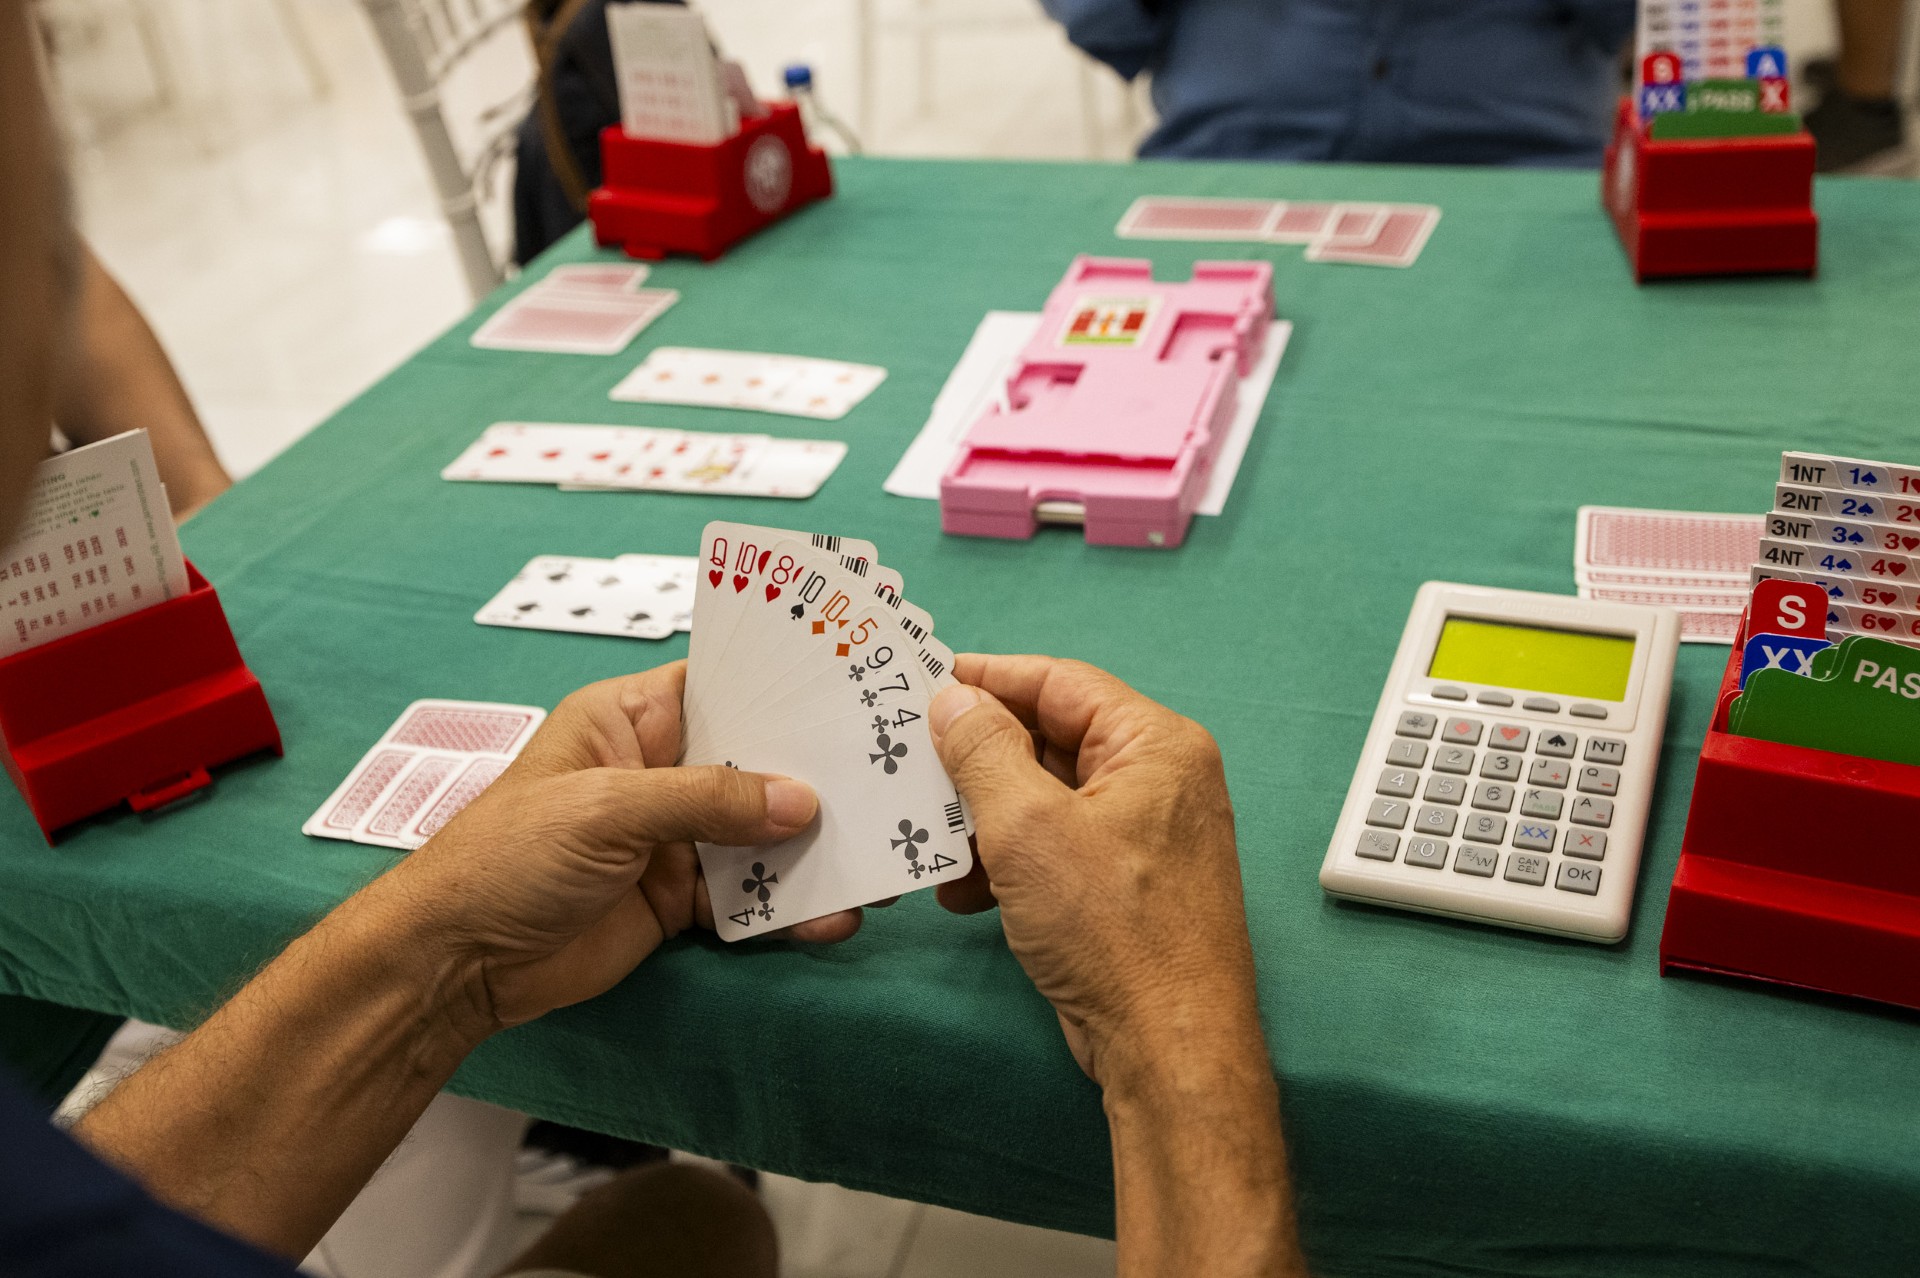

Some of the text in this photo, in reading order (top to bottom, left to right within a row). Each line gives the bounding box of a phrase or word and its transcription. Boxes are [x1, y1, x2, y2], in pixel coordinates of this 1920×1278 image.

[1790, 464, 1826, 484] 1NT
[1781, 492, 1822, 512] 2NT
[1771, 519, 1812, 539] 3NT
[1764, 547, 1804, 567] 4NT
[1776, 595, 1806, 630] S
[710, 538, 922, 729] Q 10 8 10 10 5 9 7 4
[1592, 740, 1620, 754] NT
[1402, 744, 1413, 757] 1
[1447, 750, 1463, 764] 2
[1494, 756, 1509, 770] 3
[1538, 760, 1548, 769] J
[1586, 768, 1599, 778] Q
[1390, 773, 1405, 787] 4
[1438, 778, 1454, 794] 5
[1486, 786, 1502, 800] 6
[1529, 790, 1540, 800] K
[1580, 798, 1592, 808] A
[1383, 802, 1398, 817] 7
[1428, 810, 1444, 825] 8
[1478, 817, 1494, 832] 9
[1520, 826, 1550, 840] XX
[928, 853, 958, 874] 4
[1517, 864, 1537, 874] CEL
[1518, 857, 1540, 866] CAN
[1567, 867, 1592, 881] OK
[728, 907, 756, 926] 4
